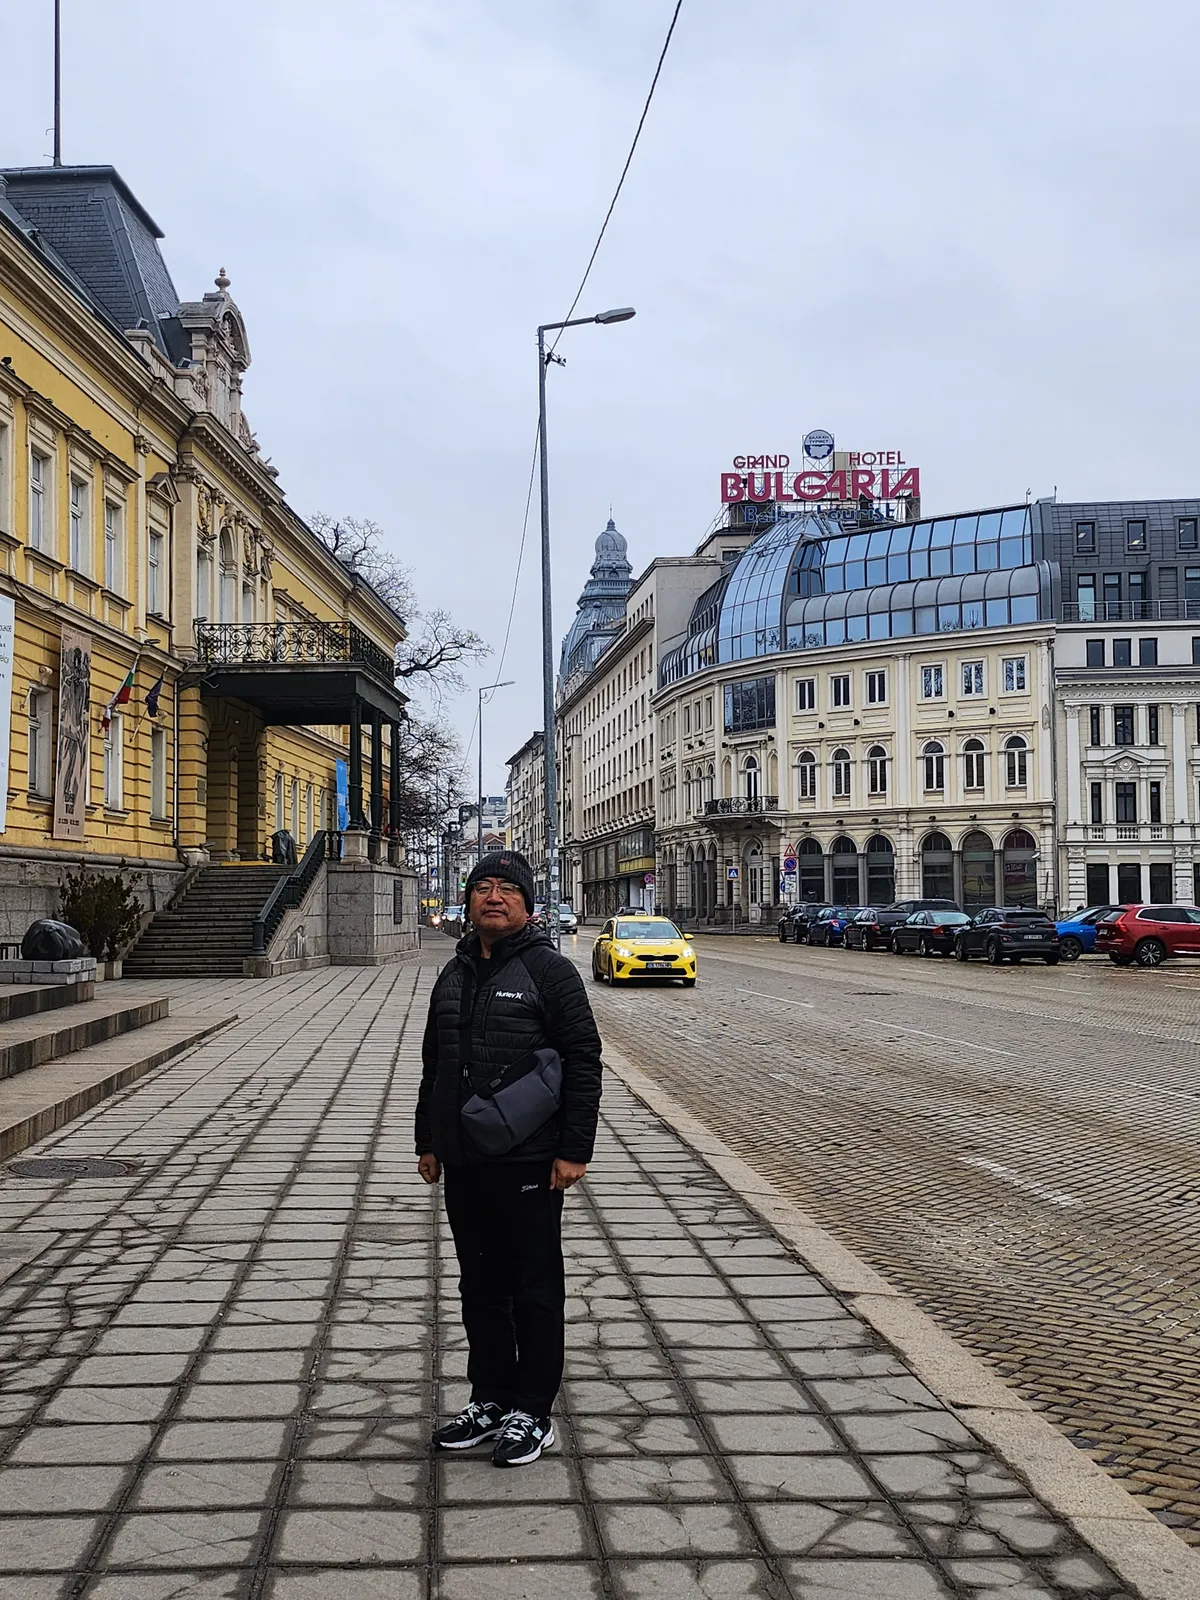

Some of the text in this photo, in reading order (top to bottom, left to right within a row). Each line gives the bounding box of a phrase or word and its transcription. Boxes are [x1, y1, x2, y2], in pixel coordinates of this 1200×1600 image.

[733, 451, 906, 469] GRAND HOTEL
[720, 467, 920, 503] BULGARIA
